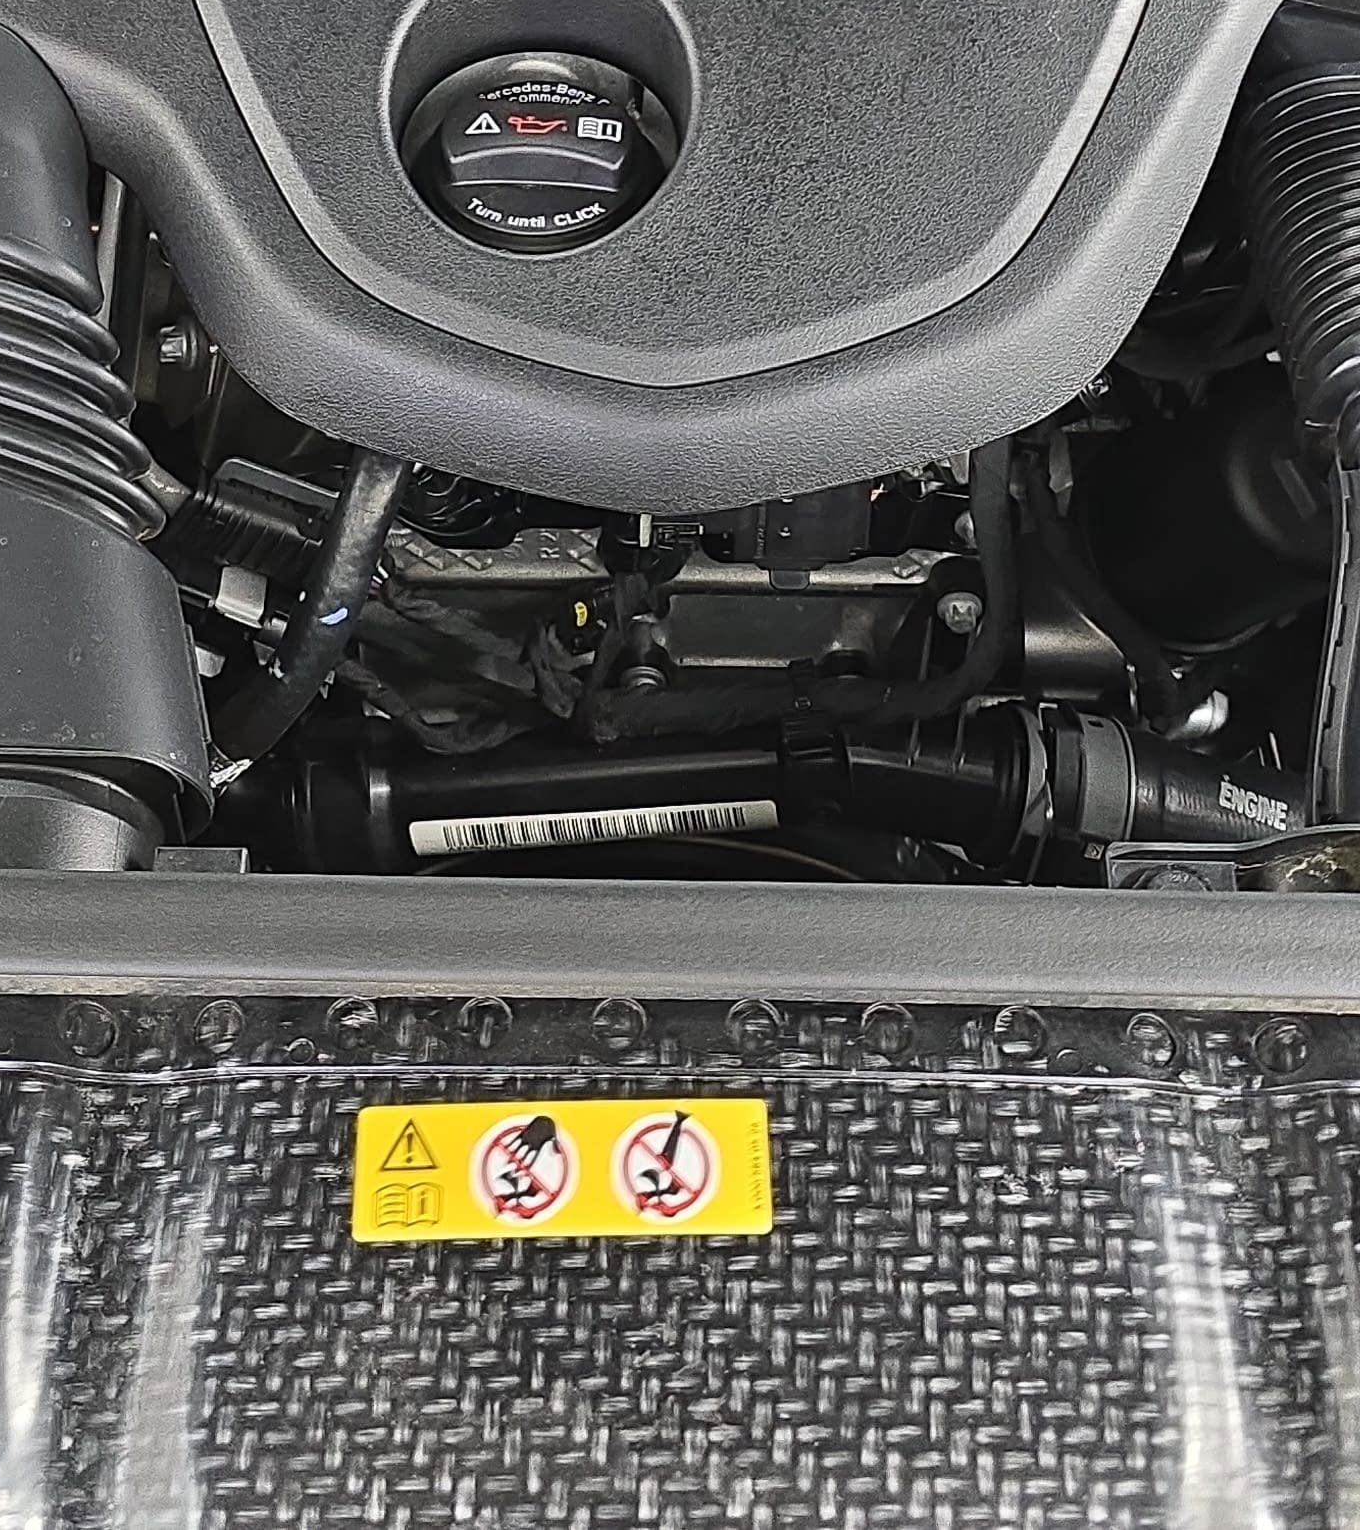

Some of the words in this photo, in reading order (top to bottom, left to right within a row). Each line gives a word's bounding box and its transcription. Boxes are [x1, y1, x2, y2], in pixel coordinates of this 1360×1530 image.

[479, 81, 596, 103] ercedes-Benz
[467, 197, 503, 223] Turn
[507, 215, 546, 229] until
[553, 201, 607, 228] CLICK
[1219, 781, 1288, 831] ENGINE
